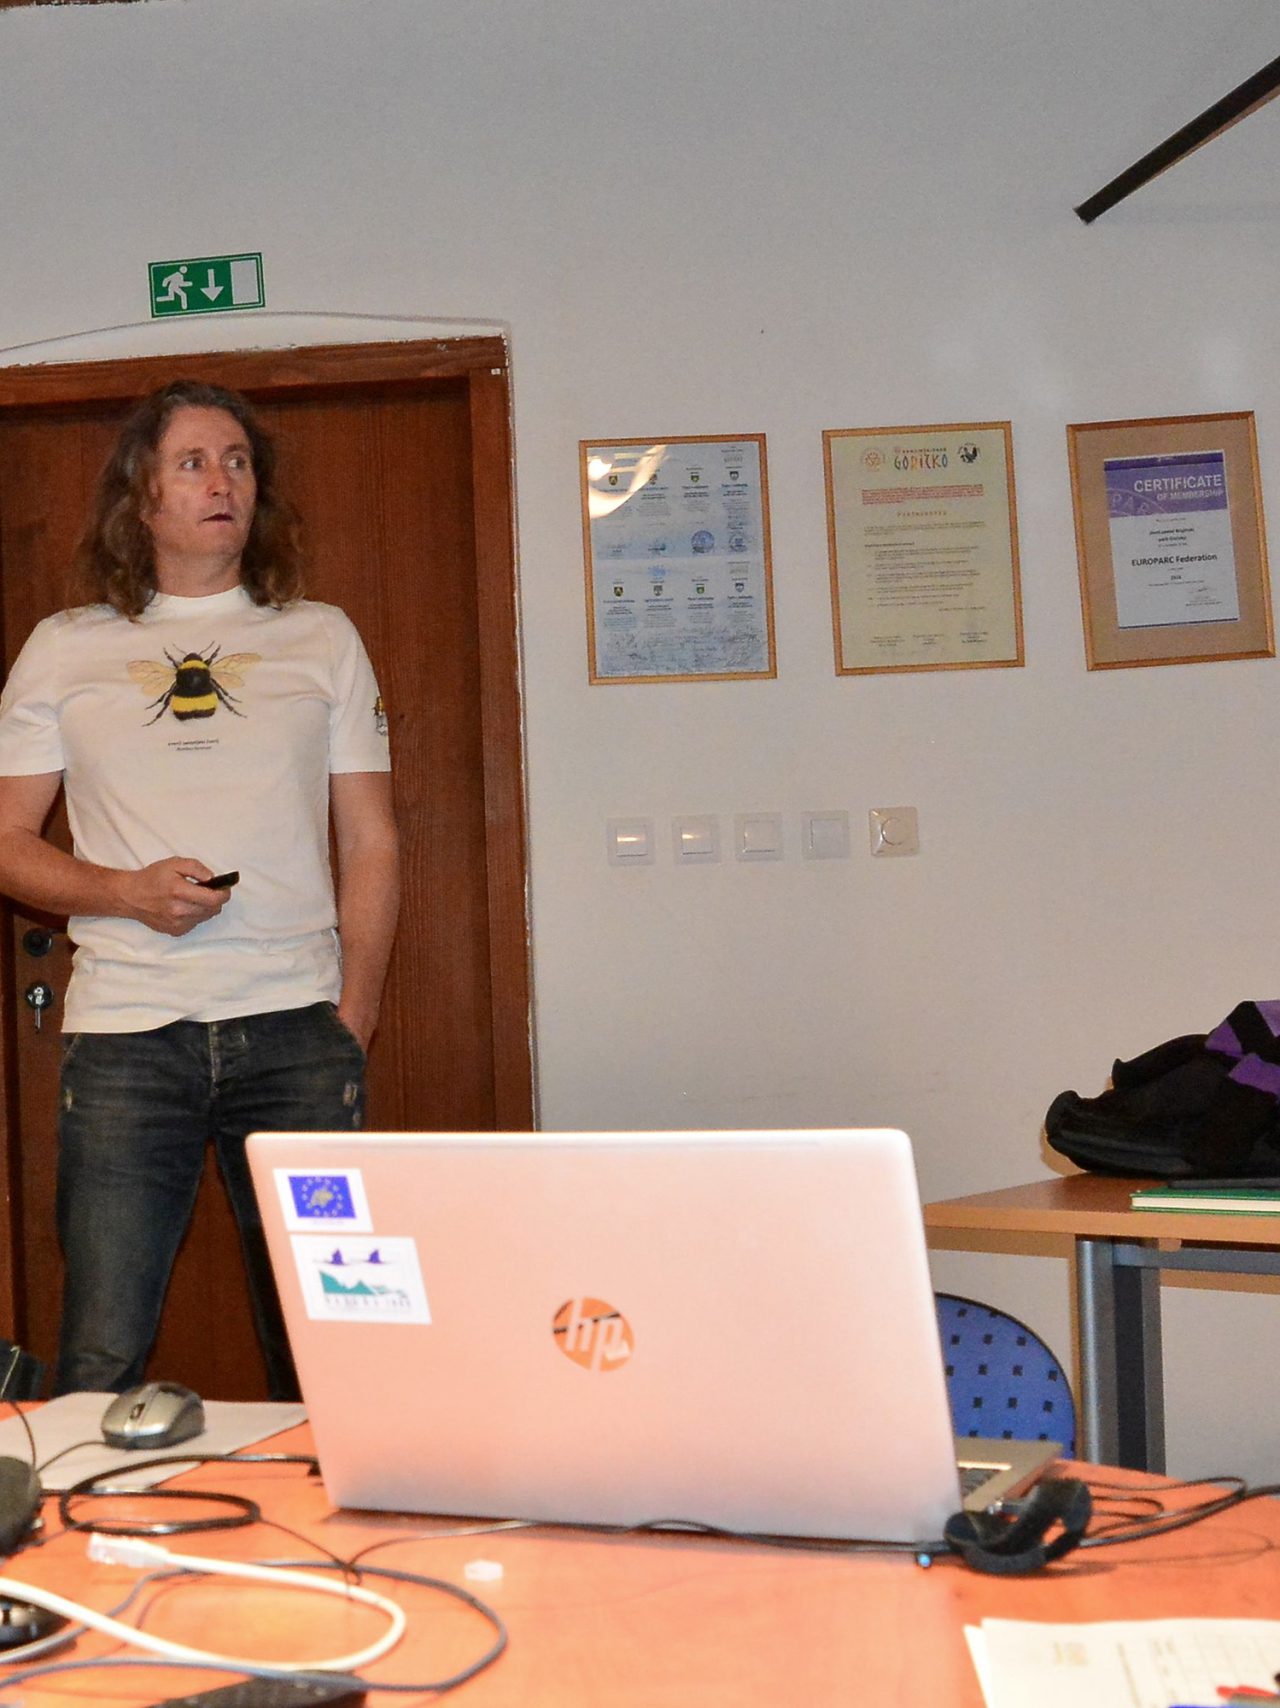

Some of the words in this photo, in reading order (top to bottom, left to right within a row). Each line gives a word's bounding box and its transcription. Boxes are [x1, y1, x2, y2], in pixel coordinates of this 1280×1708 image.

[1134, 474, 1222, 492] CERTIFICATE
[1157, 492, 1167, 501] OF
[1131, 556, 1174, 566] EUROPARC
[1176, 553, 1217, 563] Federation
[562, 1297, 628, 1371] hp
